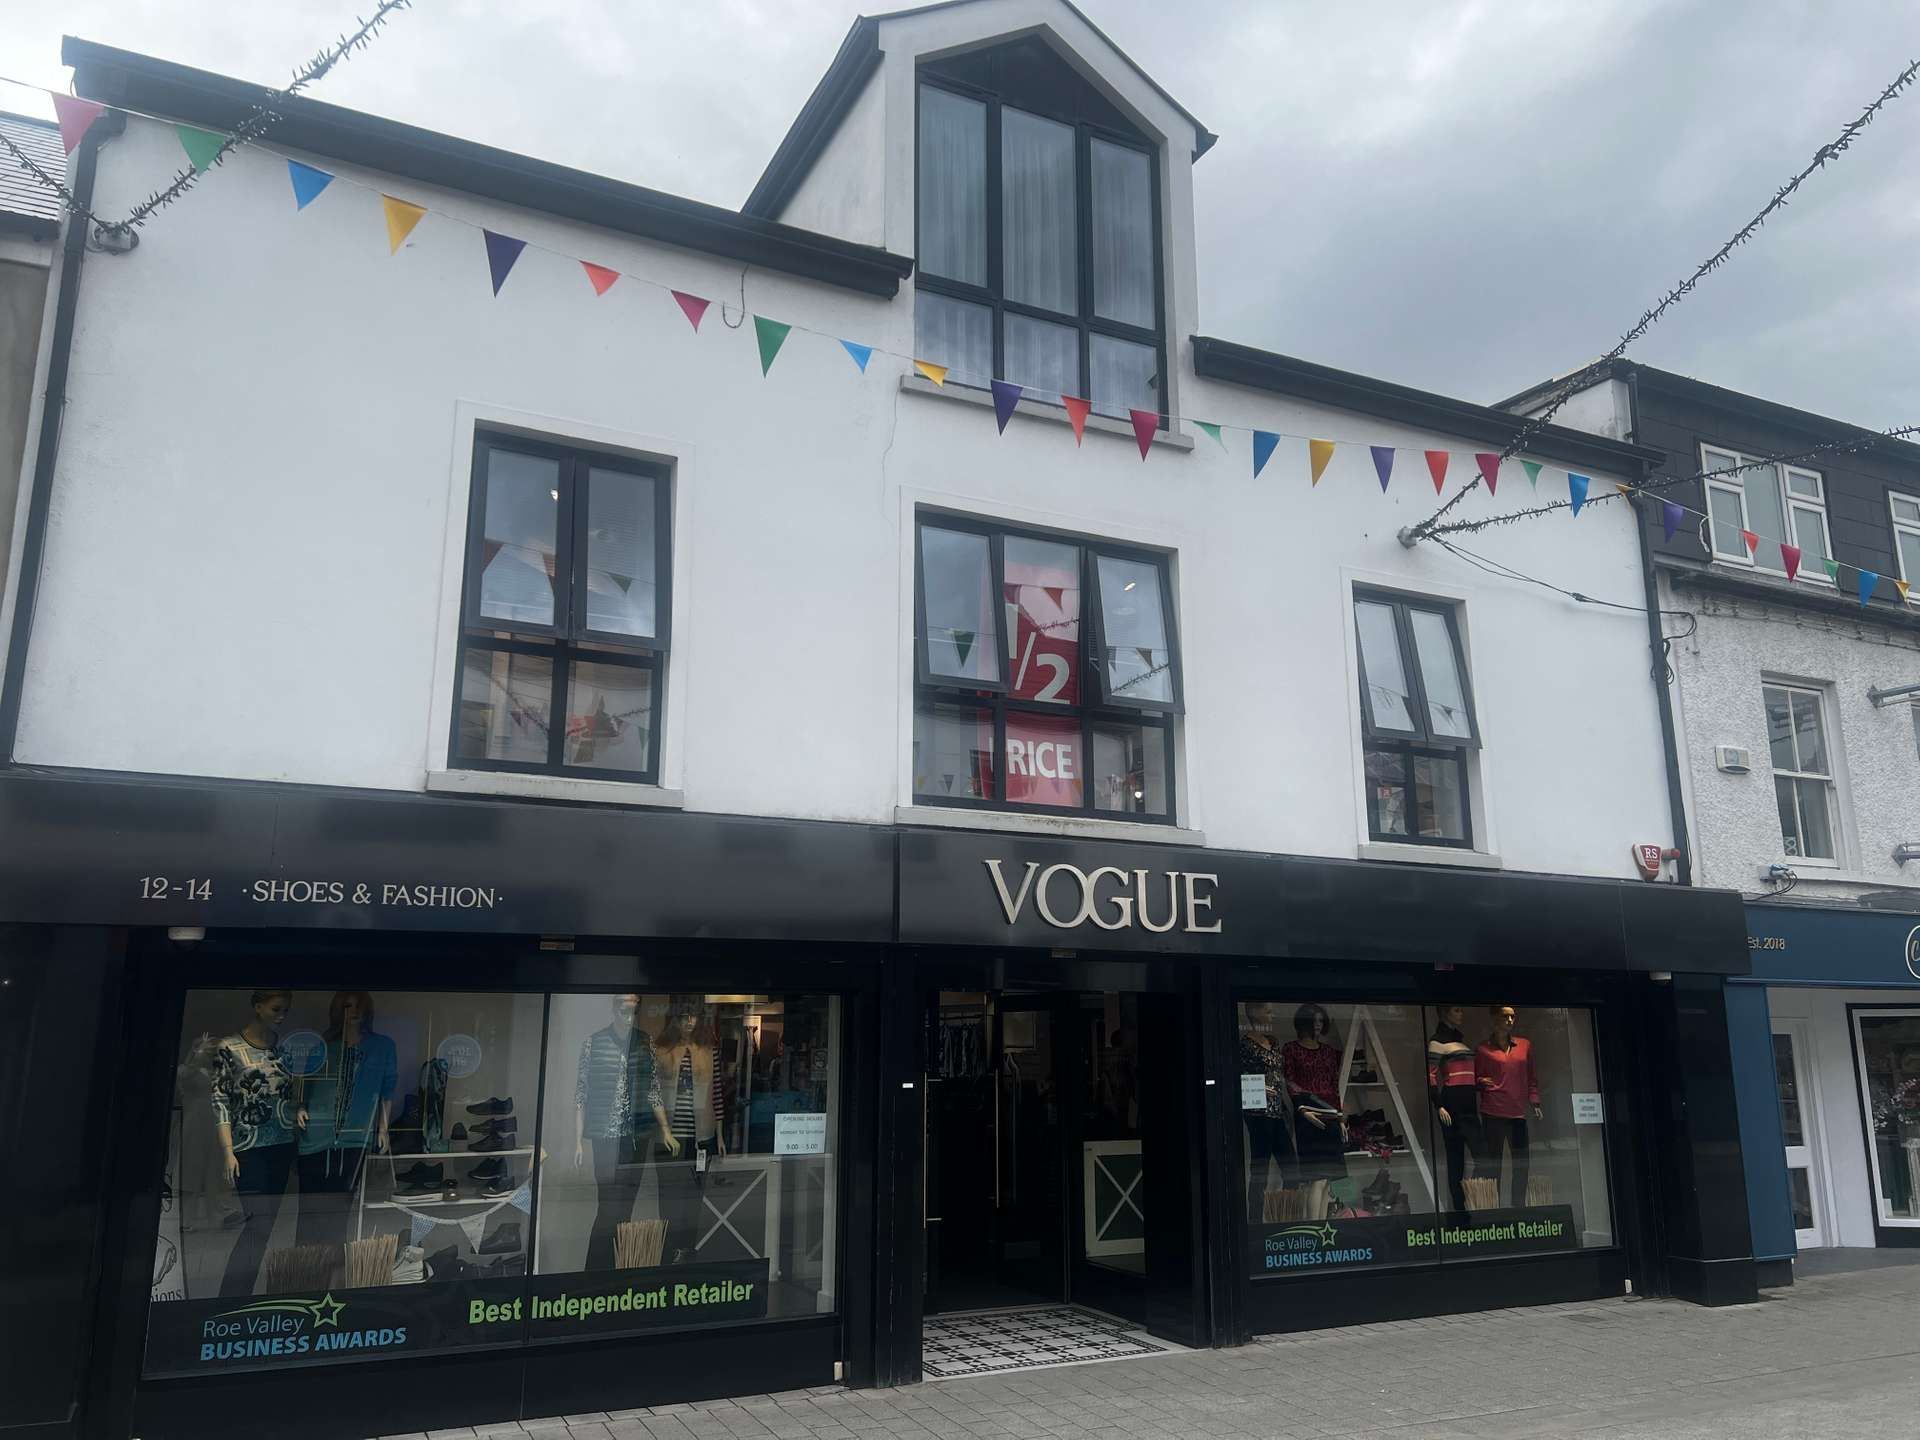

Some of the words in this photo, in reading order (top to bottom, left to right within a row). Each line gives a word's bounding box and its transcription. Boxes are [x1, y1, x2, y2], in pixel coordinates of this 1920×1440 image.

[990, 737, 1075, 780] RICE
[1644, 847, 1658, 859] RS
[139, 876, 213, 901] 12-14
[352, 882, 372, 905] &
[983, 858, 1223, 934] VOGUE
[1763, 937, 1785, 950] 2018
[1265, 1238, 1286, 1251] Roe
[1287, 1236, 1318, 1252] Valley
[1407, 1229, 1436, 1248] Best
[1440, 1224, 1515, 1247] Independent
[1518, 1220, 1563, 1239] Retailer
[1265, 1253, 1322, 1269] BUSINESS
[1324, 1247, 1373, 1264] AWARDS
[469, 1297, 522, 1323] Best
[531, 1285, 668, 1320] Independent
[673, 1280, 754, 1306] Retailer
[202, 1320, 241, 1338] Roe
[246, 1315, 304, 1335] Valley
[200, 1335, 310, 1361] BUSINESS
[314, 1327, 407, 1350] AWARDS
